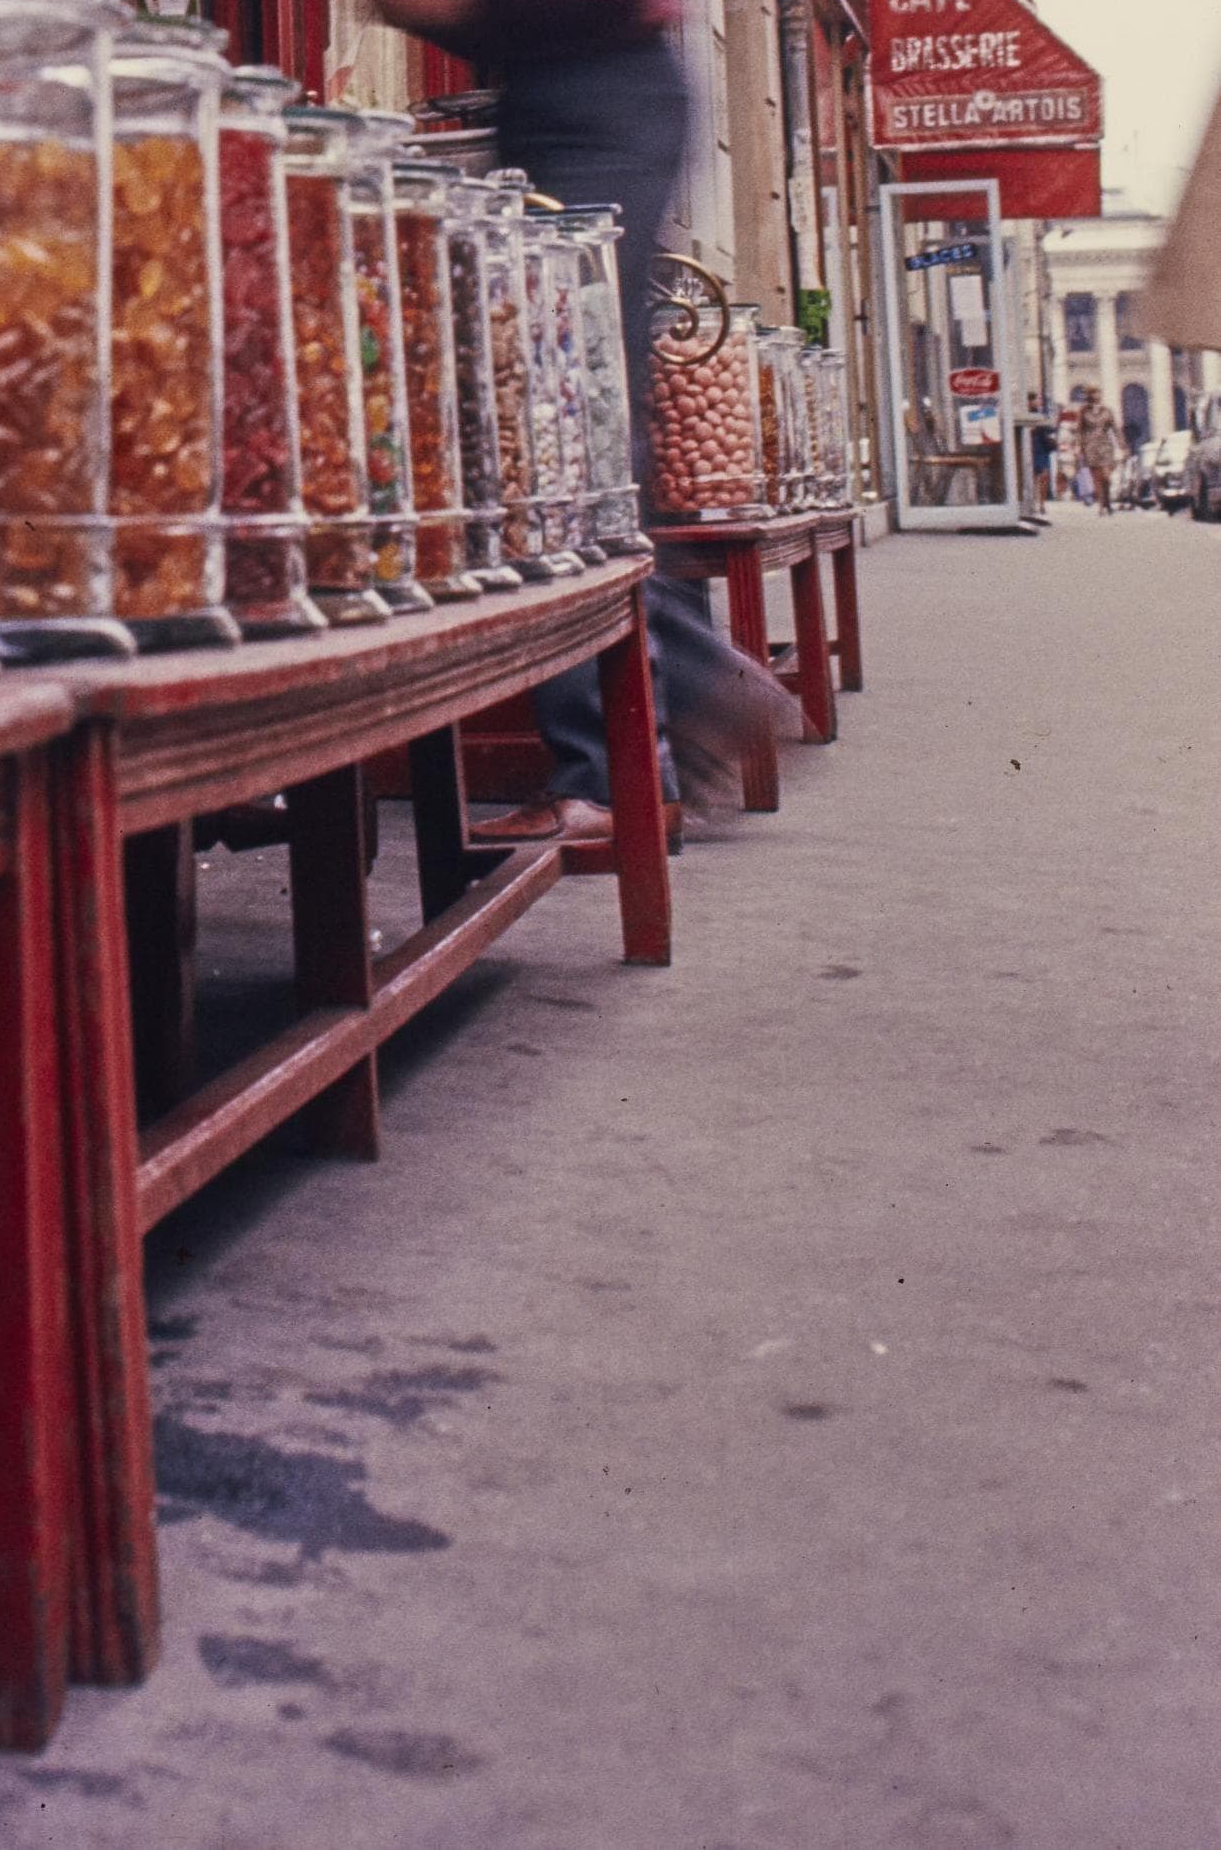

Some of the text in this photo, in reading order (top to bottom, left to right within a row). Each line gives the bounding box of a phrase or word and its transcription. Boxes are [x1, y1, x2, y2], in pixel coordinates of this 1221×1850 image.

[889, 30, 1022, 73] BRASSERIE
[893, 96, 1083, 129] STELLA ARTOIS
